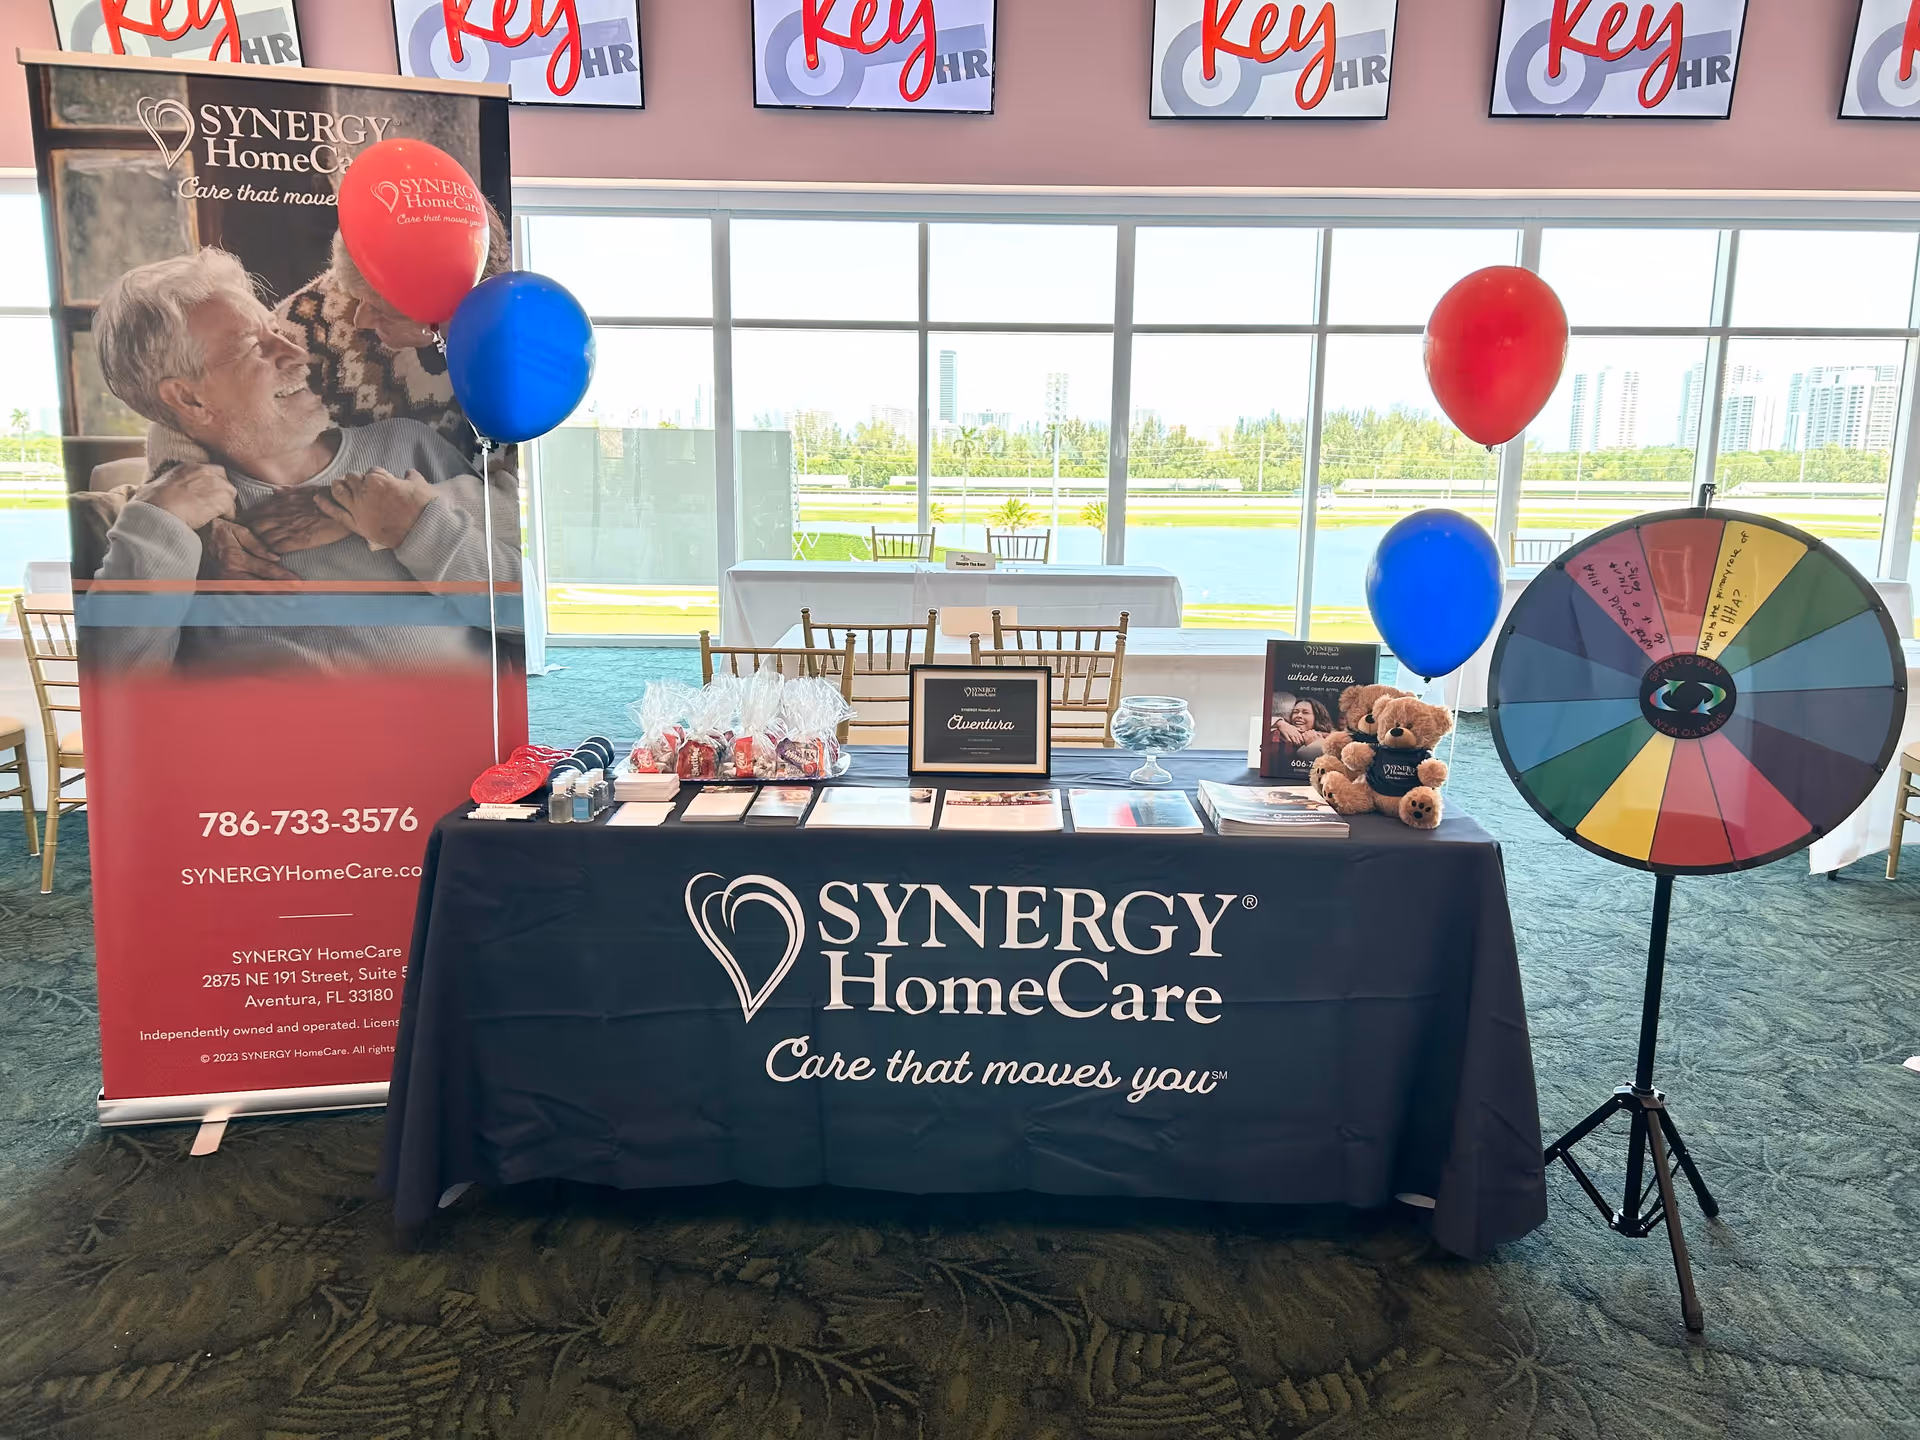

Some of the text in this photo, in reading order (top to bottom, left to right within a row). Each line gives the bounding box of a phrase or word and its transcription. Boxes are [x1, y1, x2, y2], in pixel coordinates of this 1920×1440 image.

[241, 32, 299, 65] HR
[582, 43, 638, 79] HR
[1202, 0, 1388, 110] Key HR
[1548, 0, 1731, 108] Key HR
[936, 49, 990, 84] HR
[202, 137, 353, 174] HomeCa
[178, 176, 339, 206] Care that move
[404, 194, 481, 214] HomeCare
[397, 213, 421, 224] Care
[423, 214, 441, 222] that
[443, 216, 469, 225] moves
[1740, 530, 1749, 544] of
[1716, 569, 1733, 599] primary
[1709, 604, 1720, 619] the
[1720, 589, 1747, 624] HHA?
[1709, 621, 1717, 629] is
[1700, 631, 1714, 651] What
[1287, 672, 1355, 684] whole hearts
[1649, 656, 1722, 682] SPIN TO WIN
[947, 713, 1015, 730] Aventura
[199, 807, 419, 837] 786-733-3576
[181, 863, 423, 886] SYNERGYHomeCare.co
[232, 945, 402, 965] SYNERGY HomeCare
[202, 973, 241, 988] 2875
[246, 972, 269, 986] NE
[273, 970, 297, 984] 191
[301, 969, 354, 984] Street,
[358, 966, 397, 981] Suite
[820, 950, 1223, 1025] HomeCare
[245, 988, 394, 1008] Aventura, FL 33180
[139, 1017, 400, 1042] Independently owned and operated. Licens
[213, 1052, 239, 1063] 2023
[241, 1049, 292, 1061] SYNERGY
[294, 1046, 350, 1058] HomeCare.
[352, 1045, 366, 1054] All
[368, 1044, 396, 1055] rights
[765, 1035, 875, 1084] Care
[886, 1049, 974, 1086] that
[981, 1059, 1121, 1090] moves
